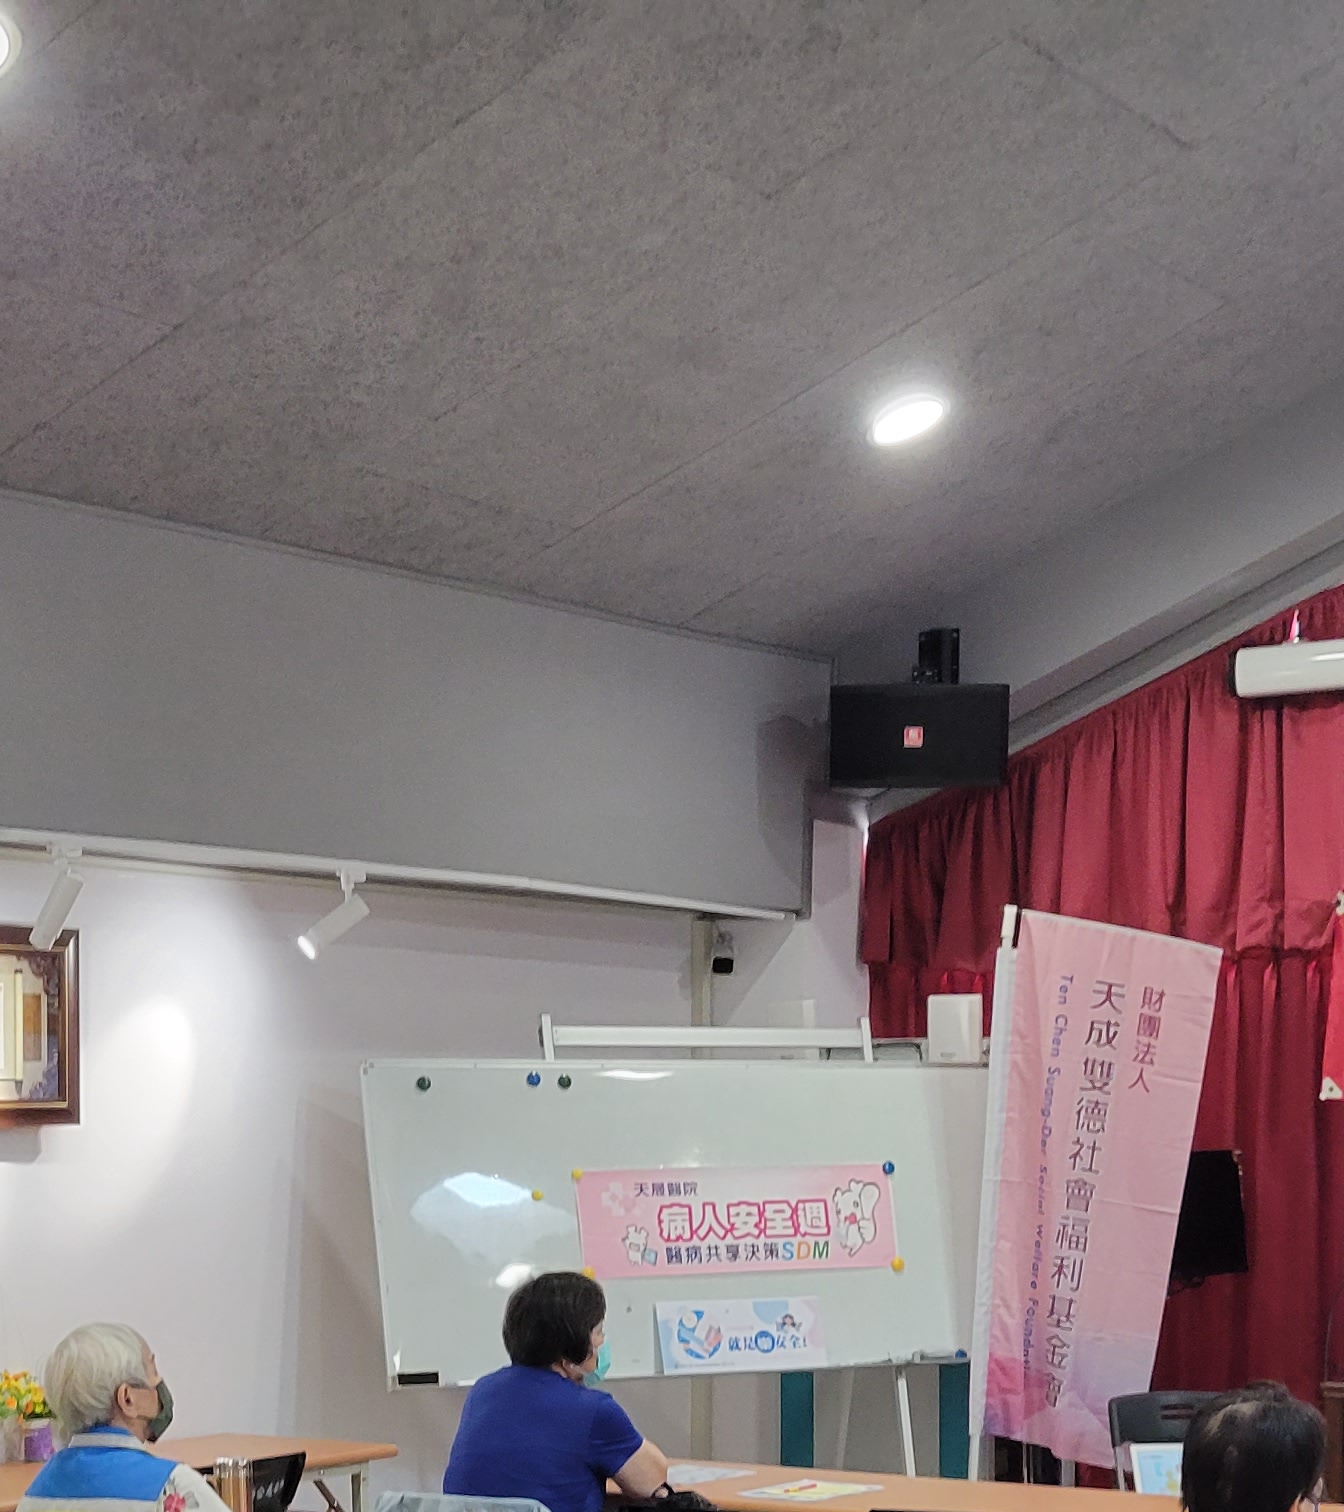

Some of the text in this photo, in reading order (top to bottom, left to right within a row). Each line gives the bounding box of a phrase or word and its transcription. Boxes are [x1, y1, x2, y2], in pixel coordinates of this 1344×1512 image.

[1058, 974, 1074, 1006] Ten
[1049, 1013, 1068, 1058] Chen
[1127, 985, 1166, 1094] 財團法人
[1045, 979, 1126, 1409] 天成雙德社會福利基金會
[657, 1198, 832, 1243] 病人安全週
[664, 1240, 831, 1266] 醫病共享決策SDM
